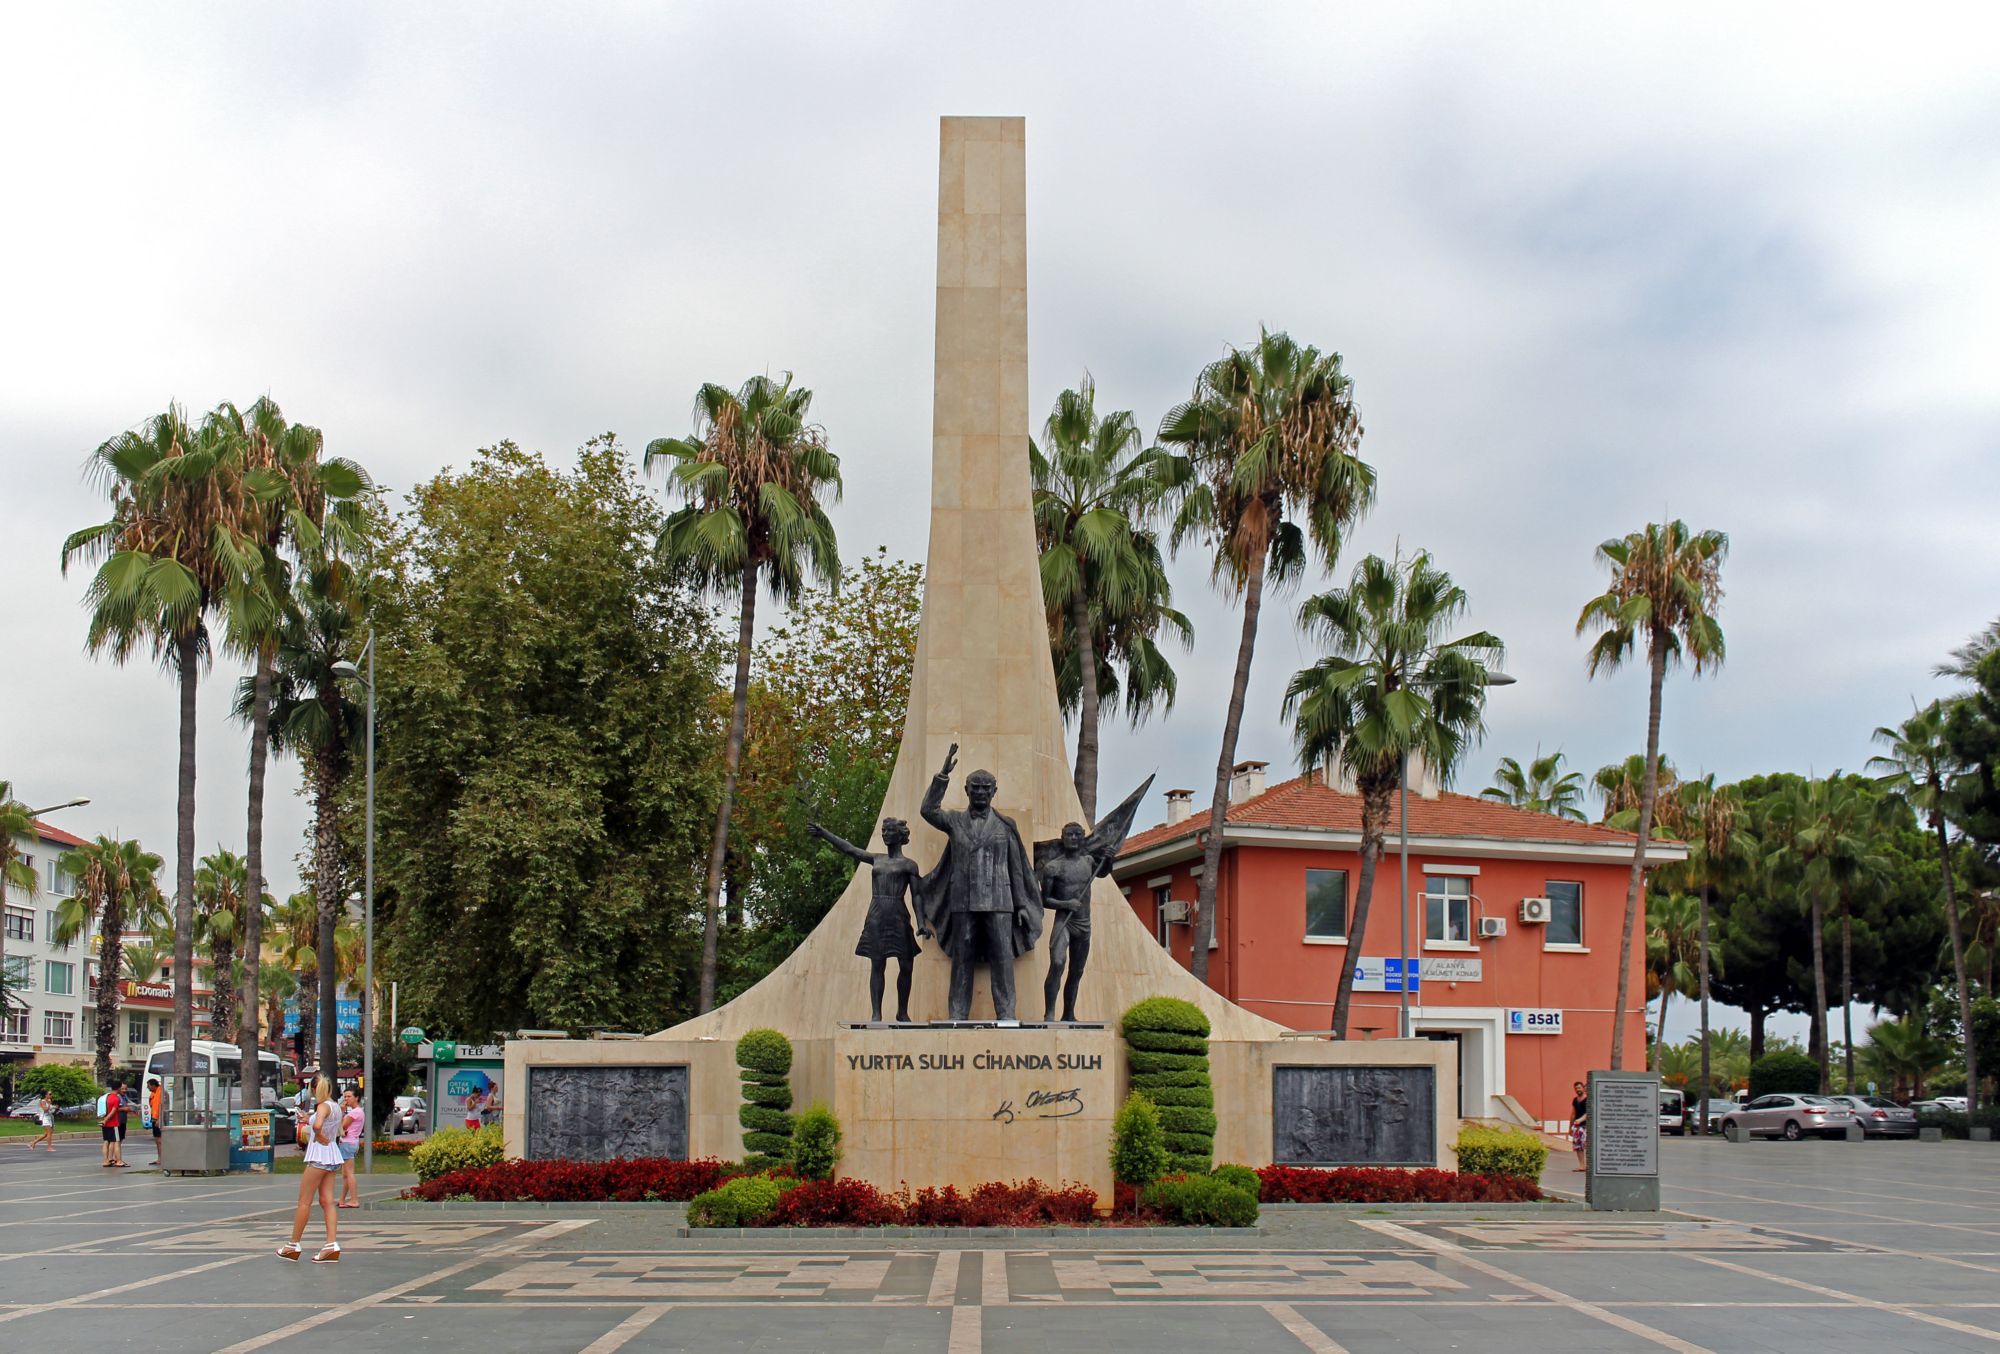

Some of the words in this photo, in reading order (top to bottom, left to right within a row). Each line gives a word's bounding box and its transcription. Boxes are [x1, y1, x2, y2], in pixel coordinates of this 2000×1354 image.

[127, 981, 175, 999] McDonald's
[1527, 1012, 1560, 1025] asat
[461, 1047, 483, 1056] TEB
[847, 1054, 914, 1070] YURTTA
[919, 1053, 964, 1070] SULH
[973, 1049, 1052, 1070] CİHANDA
[1057, 1053, 1102, 1070] SULH
[449, 1087, 470, 1095] ATM
